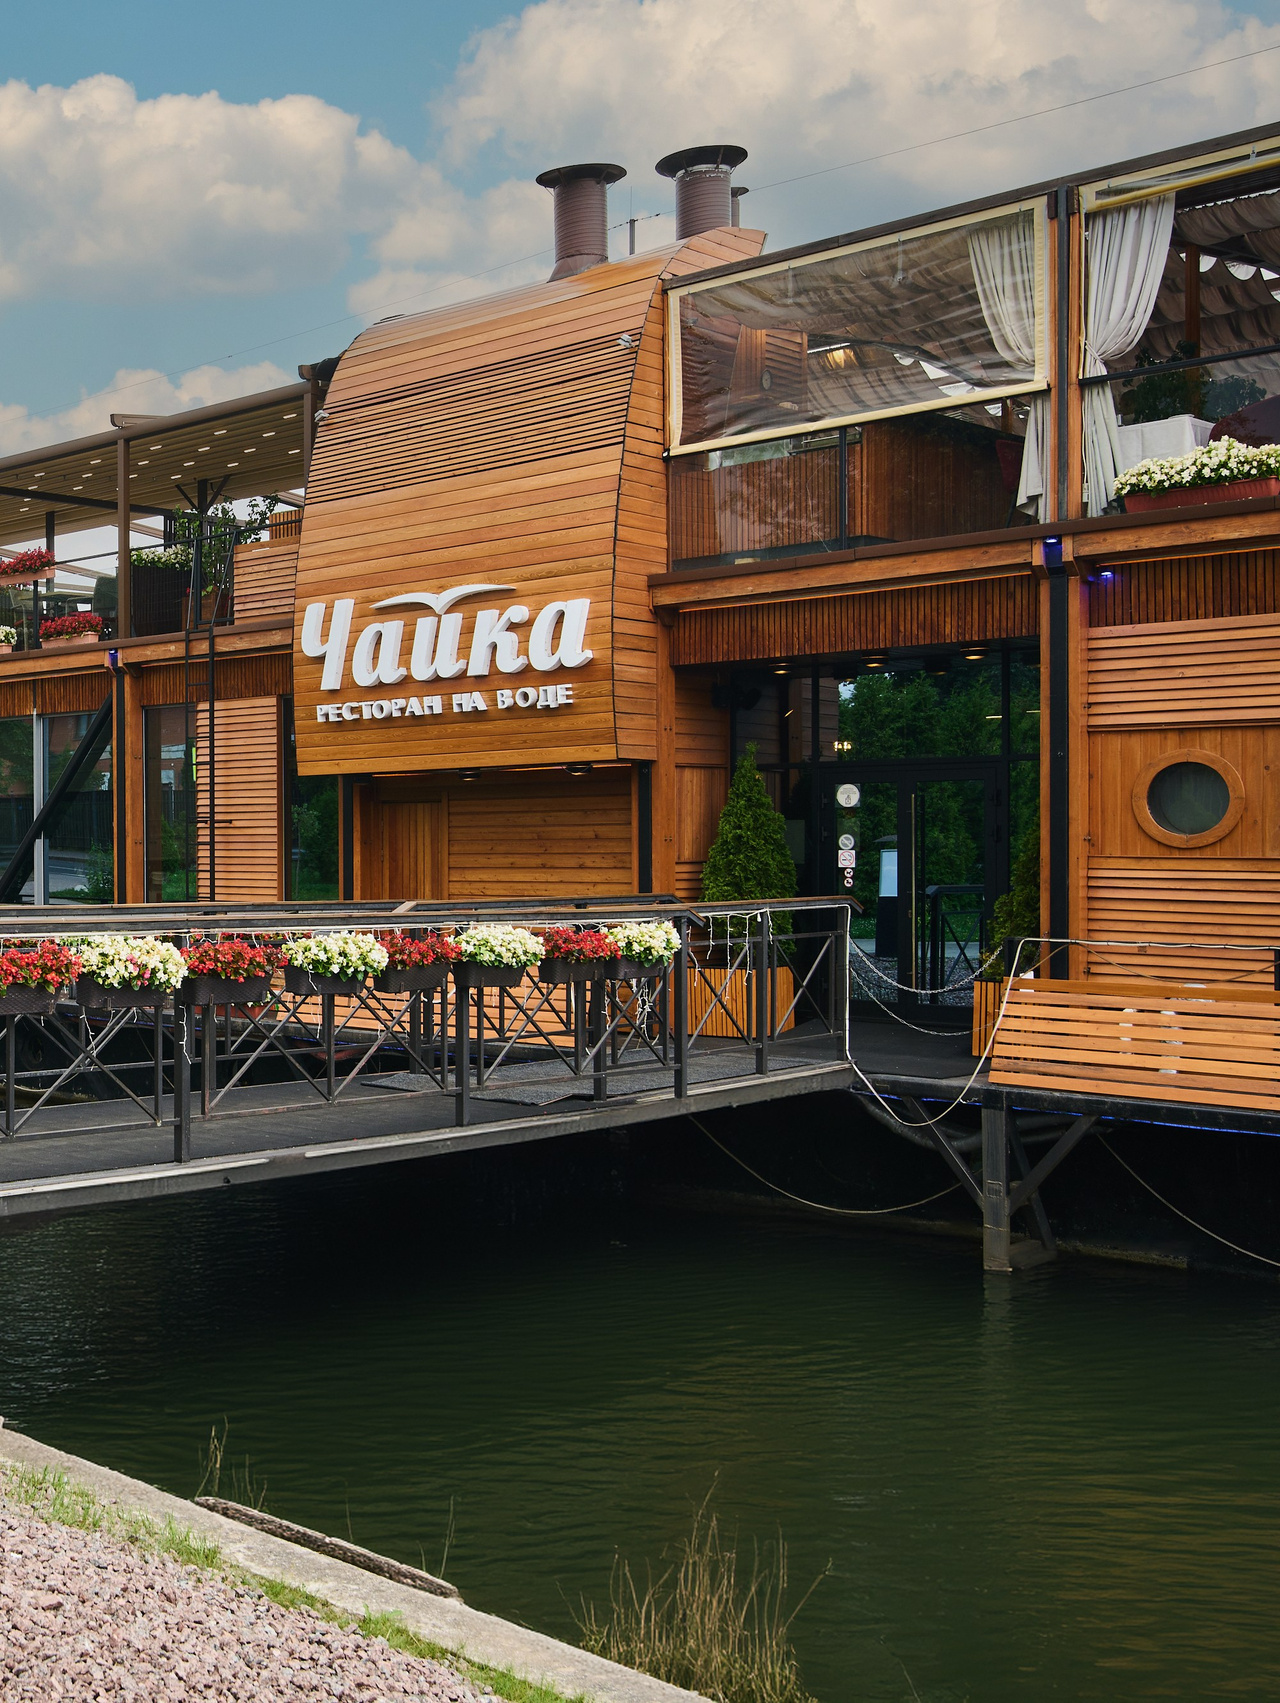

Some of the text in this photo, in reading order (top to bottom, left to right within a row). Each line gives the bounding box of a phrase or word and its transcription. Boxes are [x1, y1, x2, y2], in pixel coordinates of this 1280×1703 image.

[301, 583, 594, 691] Чайка
[316, 683, 574, 723] РЕСТОРАН НА ВОДЕ
